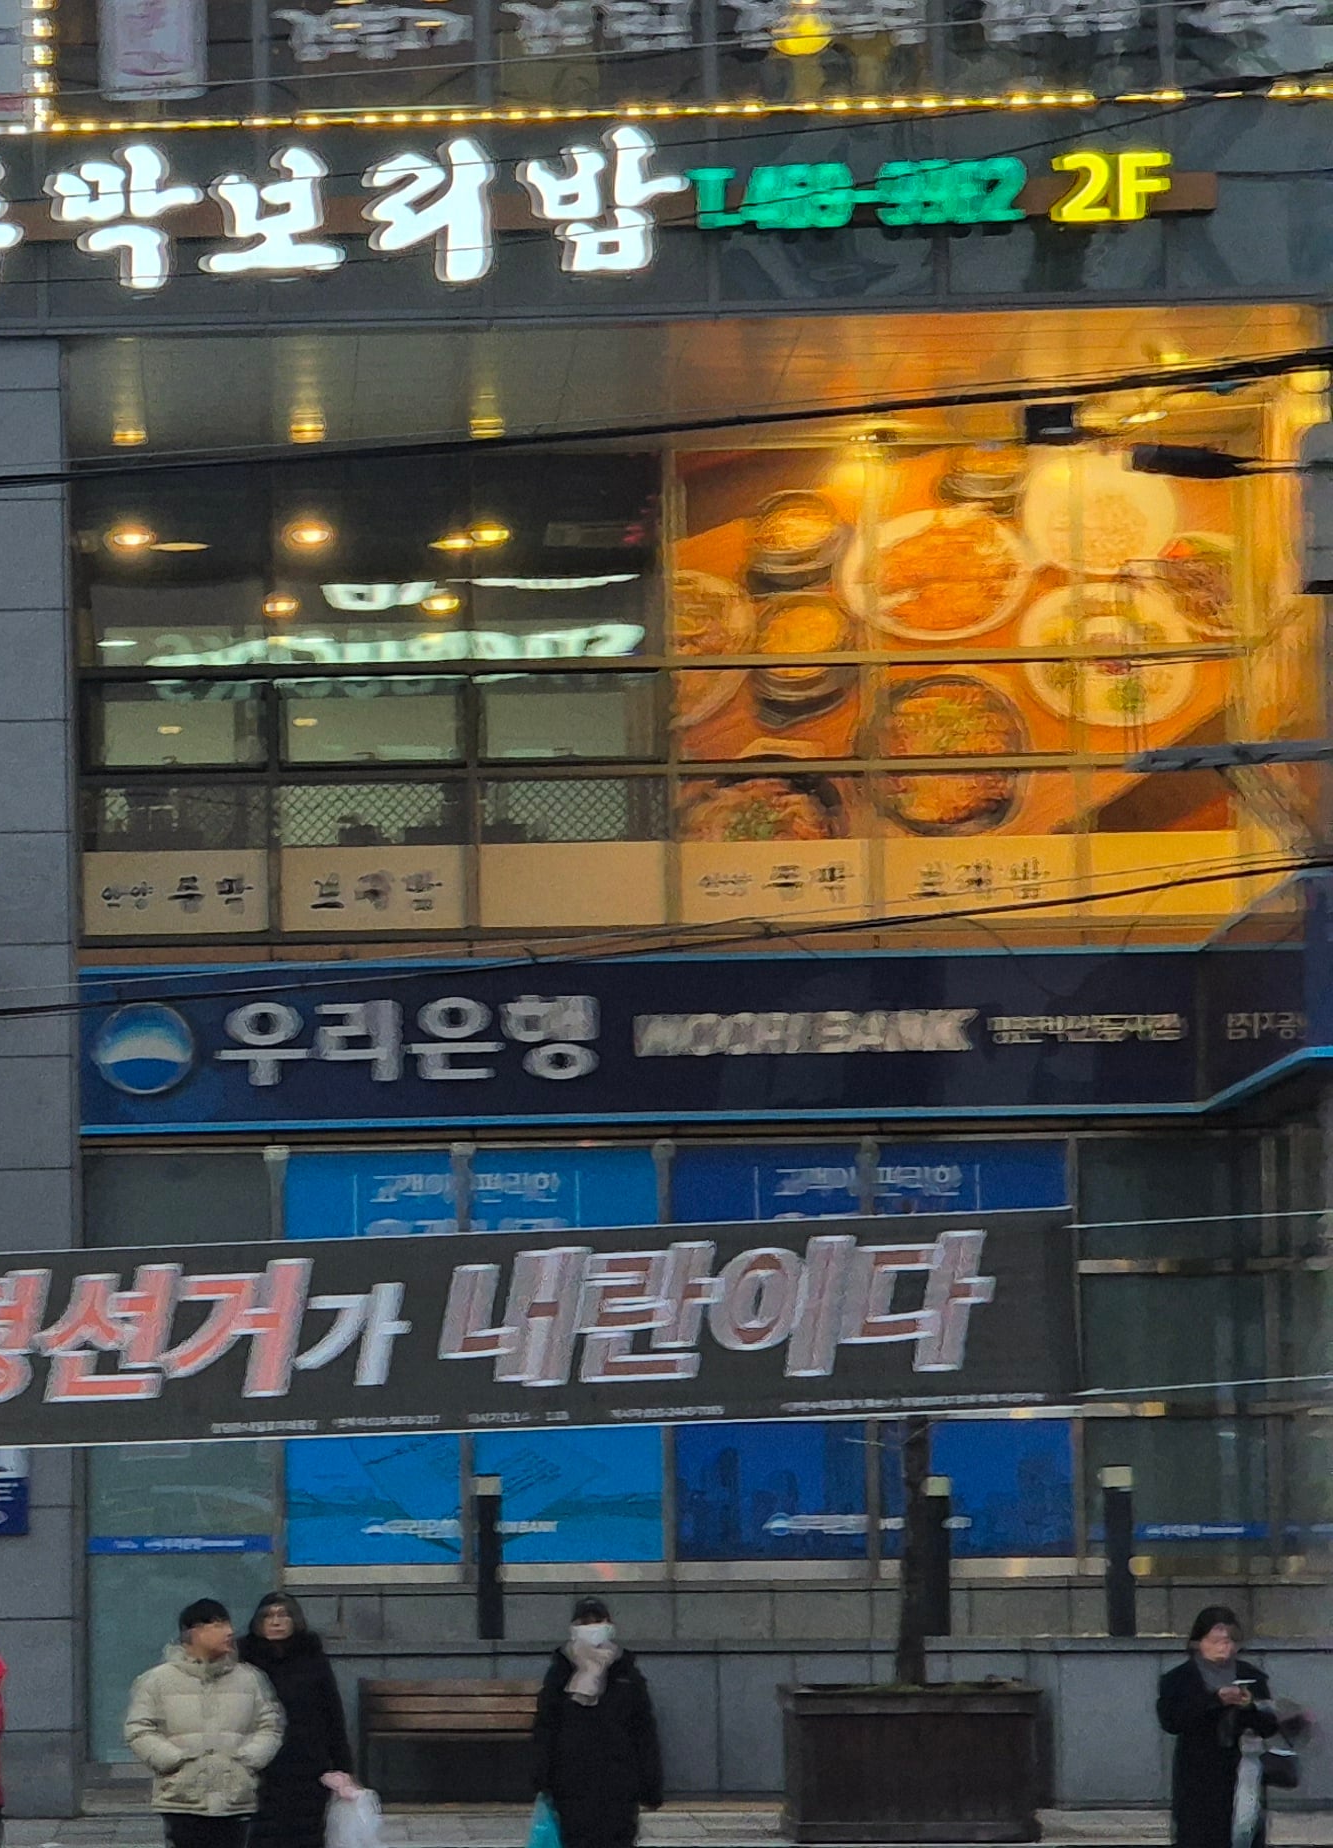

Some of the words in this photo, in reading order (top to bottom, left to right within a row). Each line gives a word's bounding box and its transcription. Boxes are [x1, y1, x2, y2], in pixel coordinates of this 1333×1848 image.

[1048, 150, 1172, 223] 2F
[214, 994, 601, 1087] 우리은행
[437, 1230, 997, 1386] 내란이다
